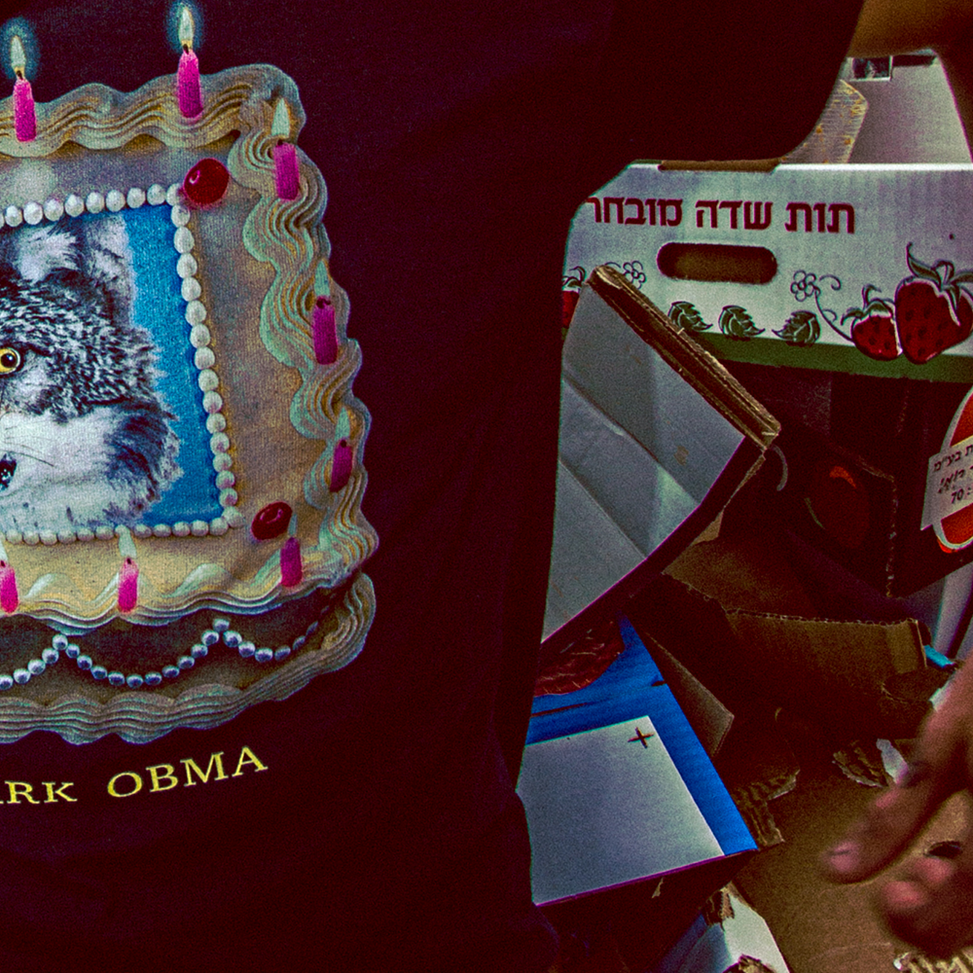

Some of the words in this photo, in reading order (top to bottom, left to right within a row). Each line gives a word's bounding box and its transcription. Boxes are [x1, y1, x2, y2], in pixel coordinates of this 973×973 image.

[584, 196, 683, 227] מובחר
[695, 199, 774, 230] שדה
[784, 201, 855, 234] תות
[106, 745, 269, 799] OBMA
